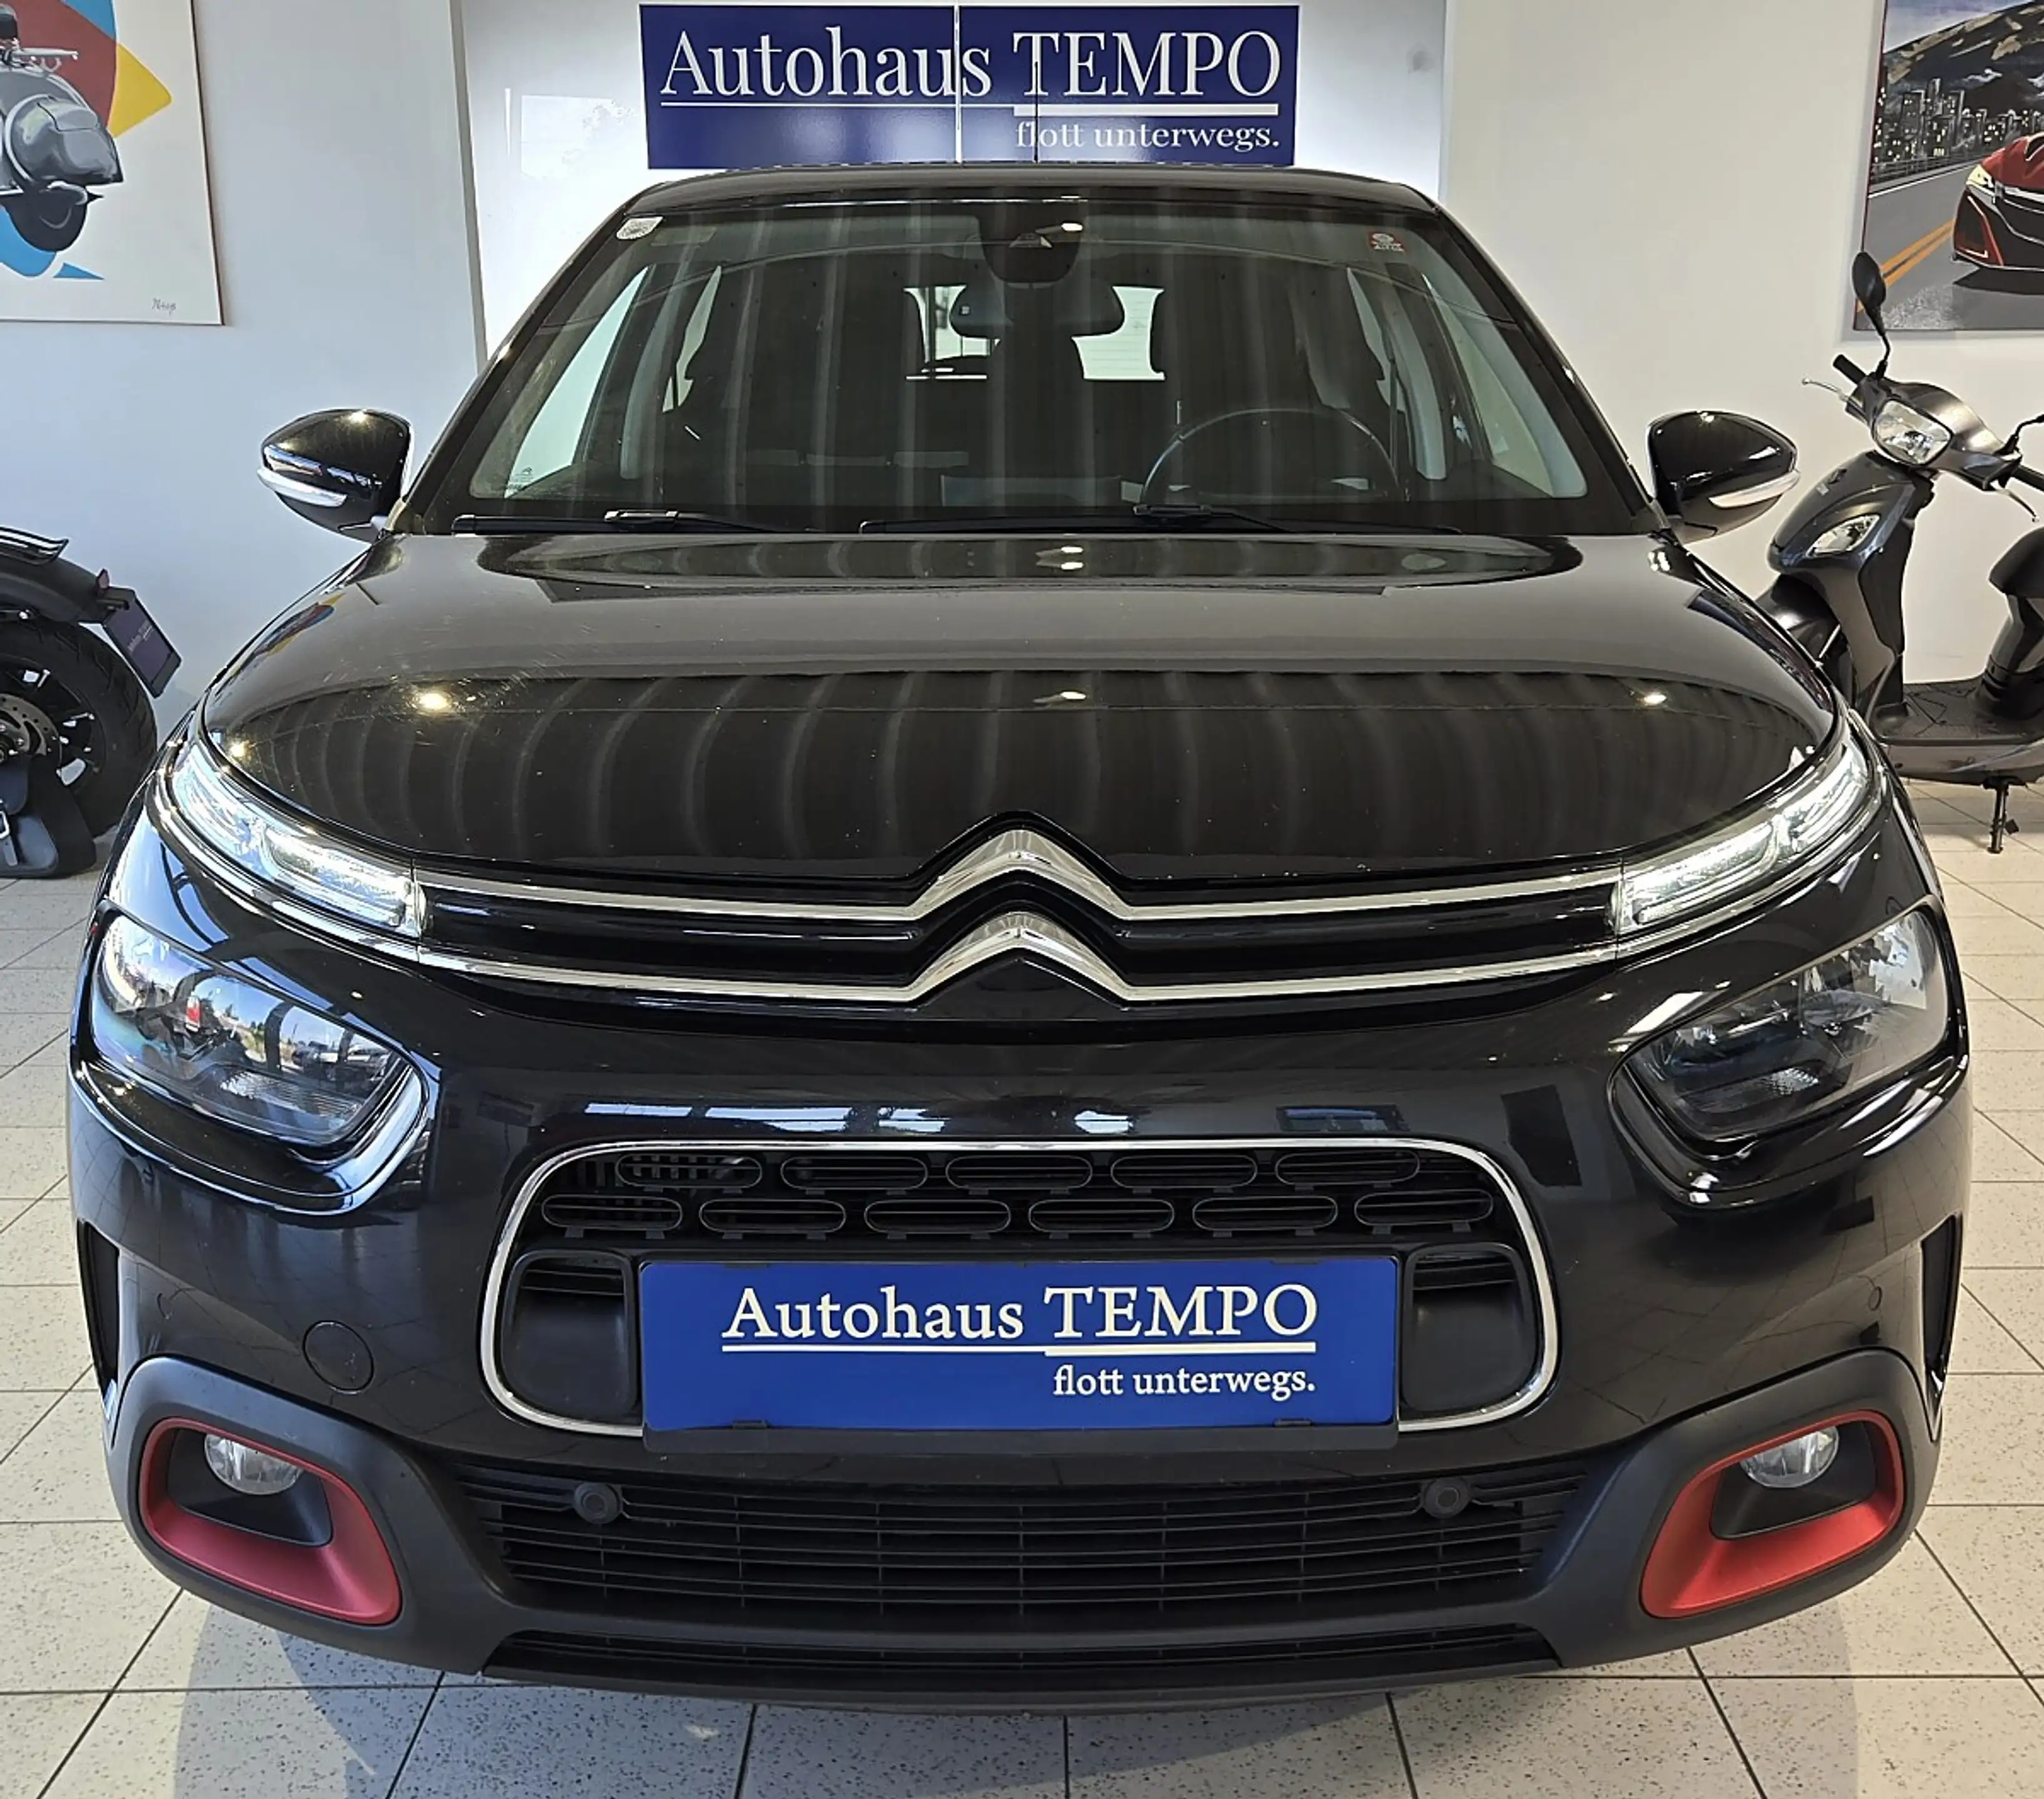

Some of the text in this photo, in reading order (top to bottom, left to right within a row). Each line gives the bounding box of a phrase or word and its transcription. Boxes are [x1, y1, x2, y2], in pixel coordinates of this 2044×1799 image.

[661, 26, 1281, 97] Autohaus TEMPO
[1015, 121, 1280, 152] flott unterwegs.
[722, 1284, 1317, 1340] Autohaus TEMPO
[1053, 1365, 1316, 1402] flott unterwegs.
